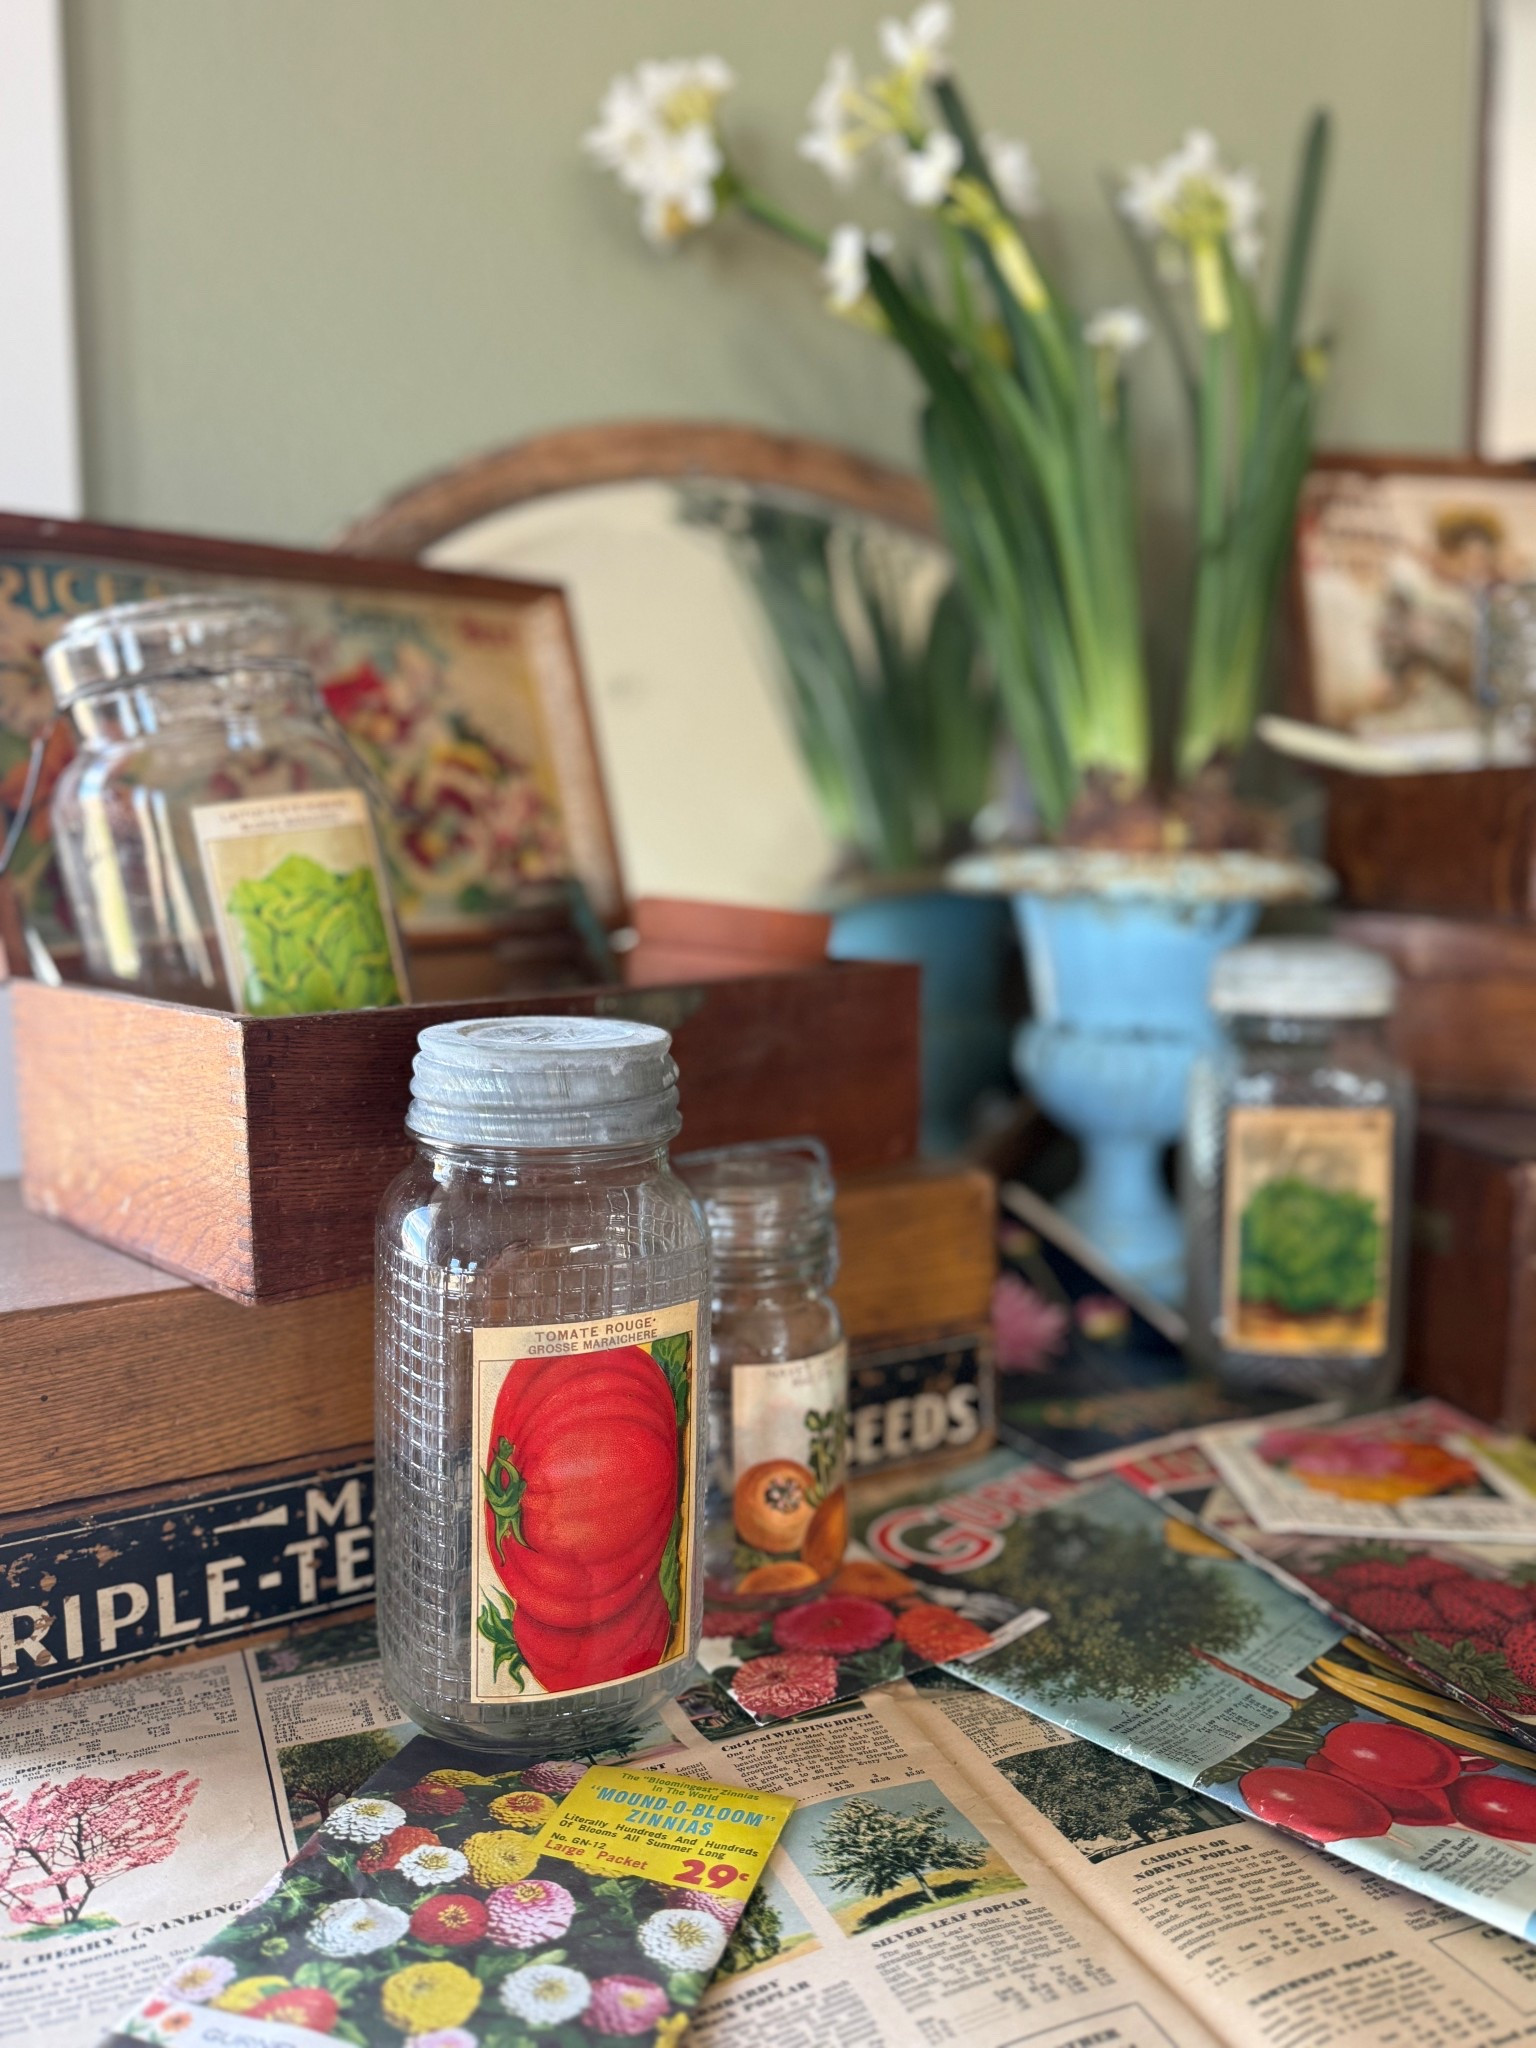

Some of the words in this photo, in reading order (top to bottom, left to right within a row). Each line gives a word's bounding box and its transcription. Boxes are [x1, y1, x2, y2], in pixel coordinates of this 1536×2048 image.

[528, 1342, 579, 1355] GROSSE
[583, 1328, 658, 1350] MARAICHERE
[534, 1326, 599, 1343] TOMATE
[305, 1479, 376, 1536] M
[185, 1729, 240, 1743] information
[721, 1734, 771, 1751] Cut-Leaf
[772, 1721, 832, 1738] WEEPING
[833, 1713, 874, 1727] BIRCH
[828, 1726, 853, 1734] Lovely
[761, 1745, 787, 1755] simply
[795, 1737, 827, 1746] couldn't
[733, 1753, 772, 1767] beautiful
[886, 1753, 909, 1761] home
[675, 1761, 704, 1773] Locust
[736, 1760, 773, 1772] Weeping
[741, 1764, 779, 1778] drooping
[744, 1775, 759, 1783] cut
[760, 1772, 789, 1783] groups
[786, 1778, 808, 1787] have
[621, 1773, 641, 1782] The
[720, 1788, 759, 1801] Zinnias
[652, 1785, 663, 1793] In
[666, 1786, 685, 1796] The
[688, 1789, 719, 1801] World
[591, 1784, 776, 1827] "MOUND-O-BLOOM"
[624, 1810, 714, 1836] ZINNIAS
[550, 1832, 568, 1842] No.
[571, 1837, 607, 1849] GN-12
[559, 1820, 574, 1828] Of
[578, 1824, 618, 1838] Blooms
[623, 1833, 640, 1842] All
[646, 1838, 693, 1854] Summer
[698, 1848, 726, 1860] Long
[564, 1813, 609, 1829] Literally
[615, 1823, 668, 1840] Hundreds
[675, 1836, 698, 1846] And
[705, 1841, 759, 1857] Hundreds
[543, 1840, 586, 1857] Large
[596, 1850, 649, 1870] Packet
[1141, 1845, 1208, 1866] CAROLINA
[1209, 1839, 1230, 1848] OR
[1133, 1857, 1195, 1881] NORWAY
[1199, 1844, 1253, 1860] POPLAR
[1174, 1864, 1216, 1879] wonderful
[871, 1926, 928, 1949] SILVER
[930, 1912, 968, 1929] LEAF
[971, 1898, 1031, 1917] POPLAR
